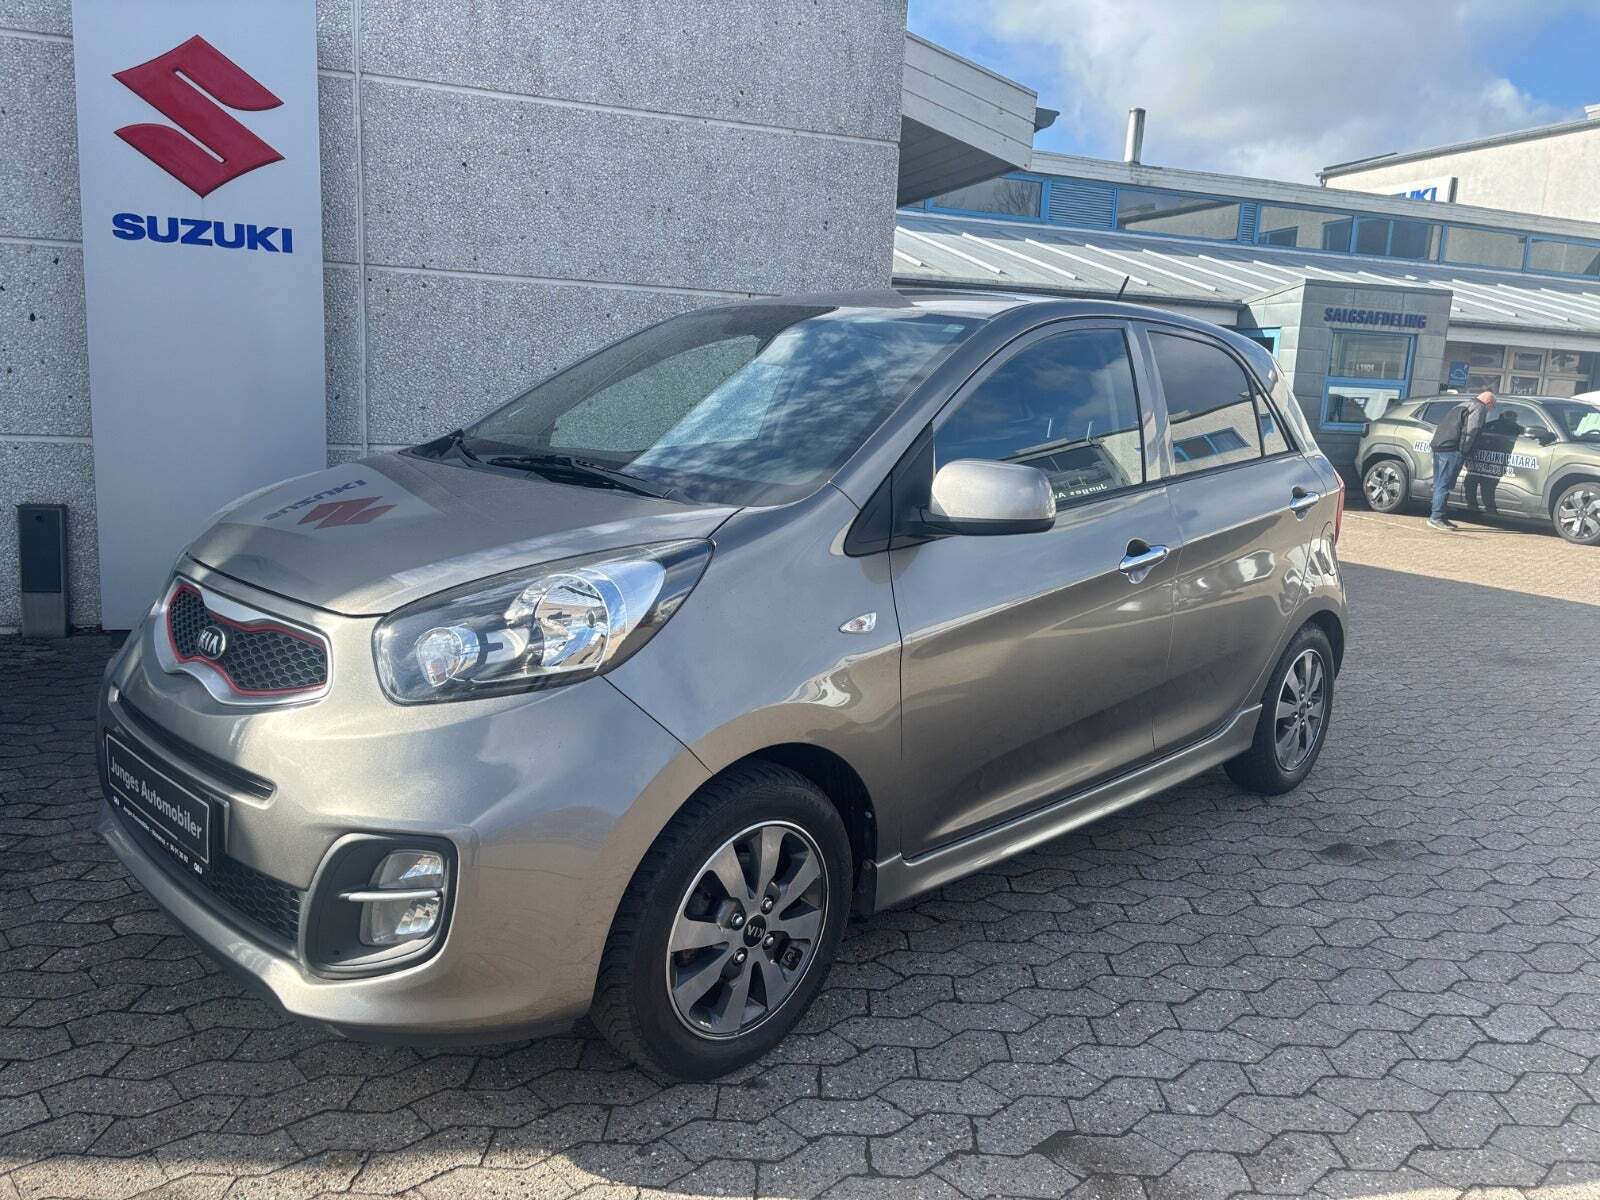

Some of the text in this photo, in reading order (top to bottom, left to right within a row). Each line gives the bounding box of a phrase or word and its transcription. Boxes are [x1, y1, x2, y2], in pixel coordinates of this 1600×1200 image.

[112, 212, 293, 254] SUZUKI
[201, 629, 218, 655] KIA
[111, 756, 139, 793] Junges
[141, 780, 202, 839] Automobiler
